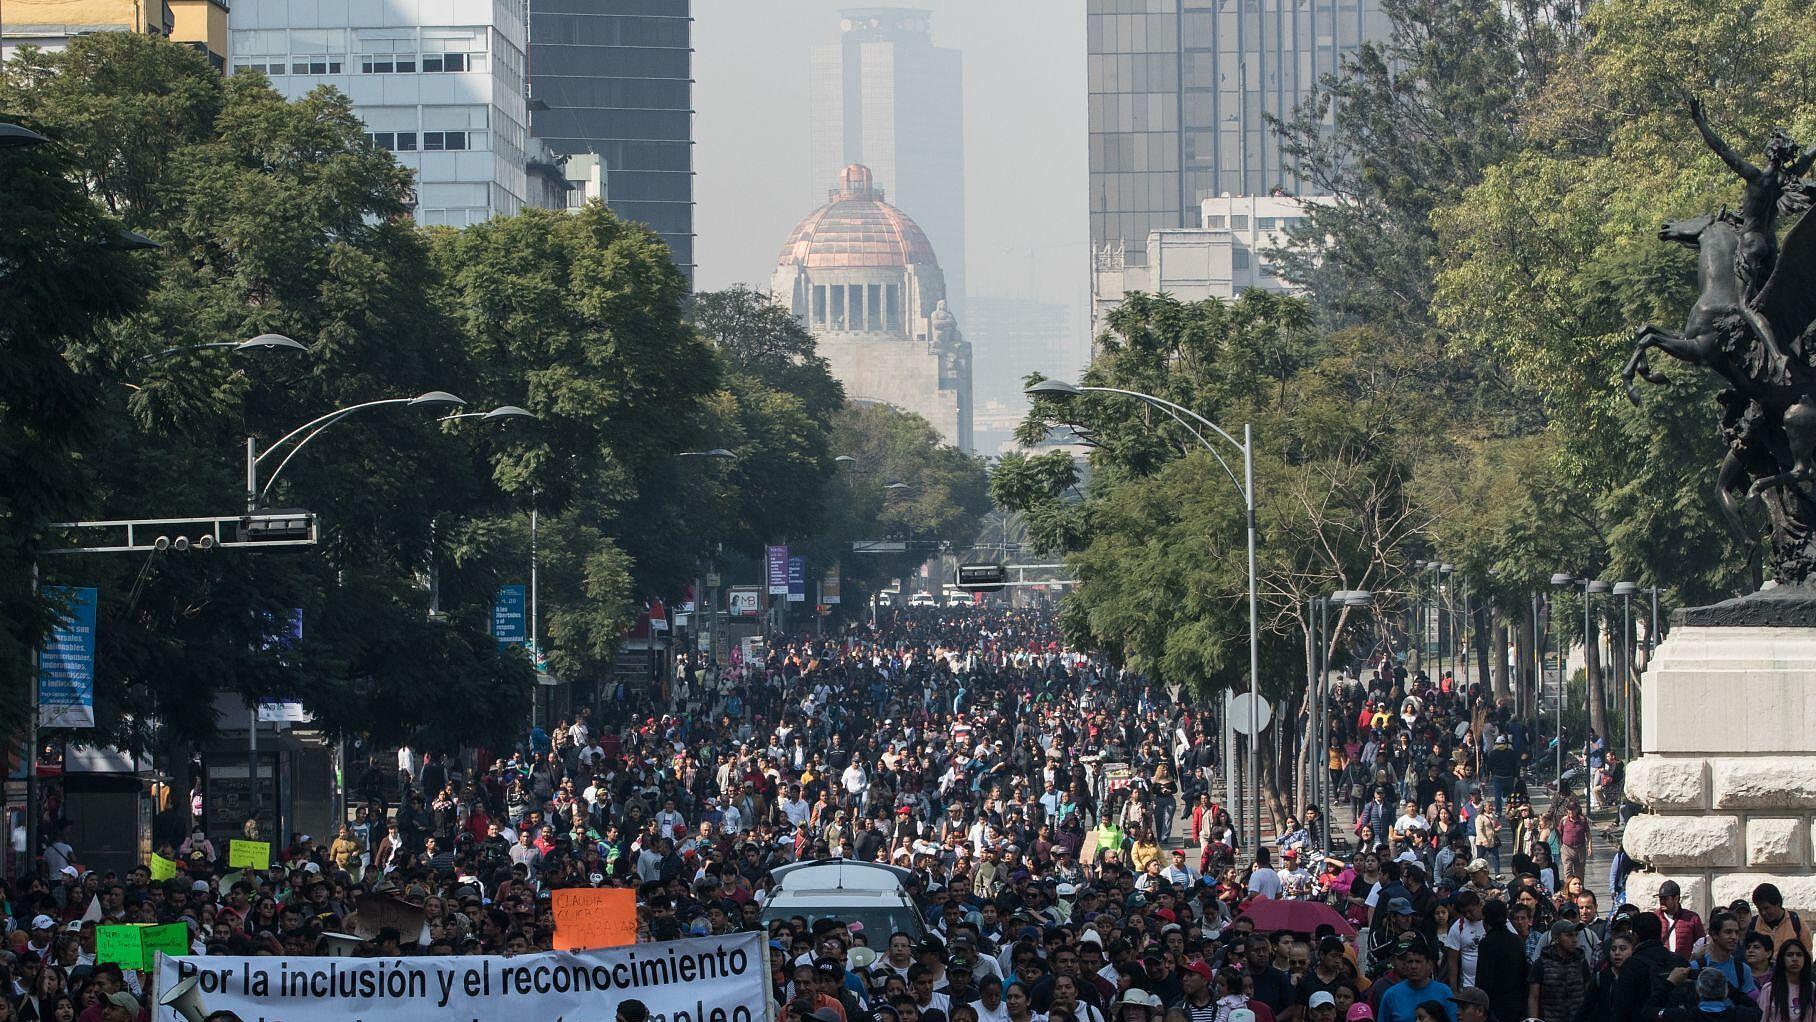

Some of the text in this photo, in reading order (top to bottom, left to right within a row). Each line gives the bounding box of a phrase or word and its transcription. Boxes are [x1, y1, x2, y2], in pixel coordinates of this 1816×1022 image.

[178, 944, 748, 1008] Por la inclusión y el reconocimiento
